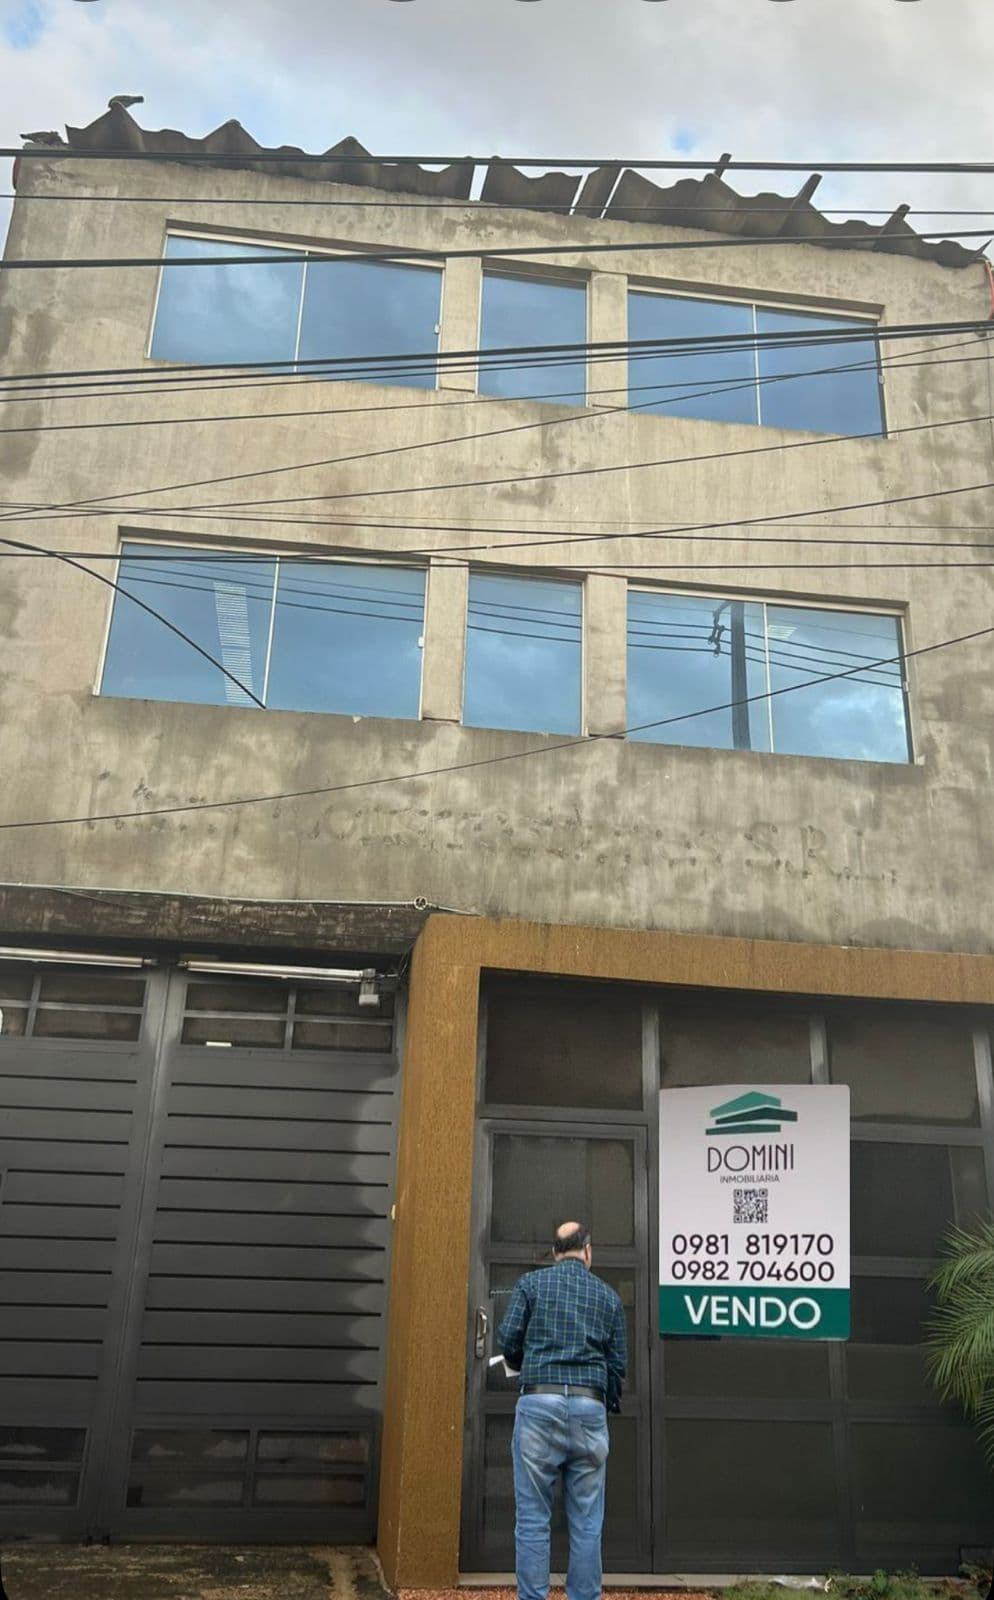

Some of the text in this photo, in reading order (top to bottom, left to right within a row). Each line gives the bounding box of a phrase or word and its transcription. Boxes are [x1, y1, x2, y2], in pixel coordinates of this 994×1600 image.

[707, 1144, 795, 1173] DOMINI
[719, 1174, 780, 1184] INMOBILIARIA
[671, 1233, 834, 1256] 0981 819170
[671, 1260, 835, 1282] 0982 704600
[684, 1295, 822, 1330] VENDO
